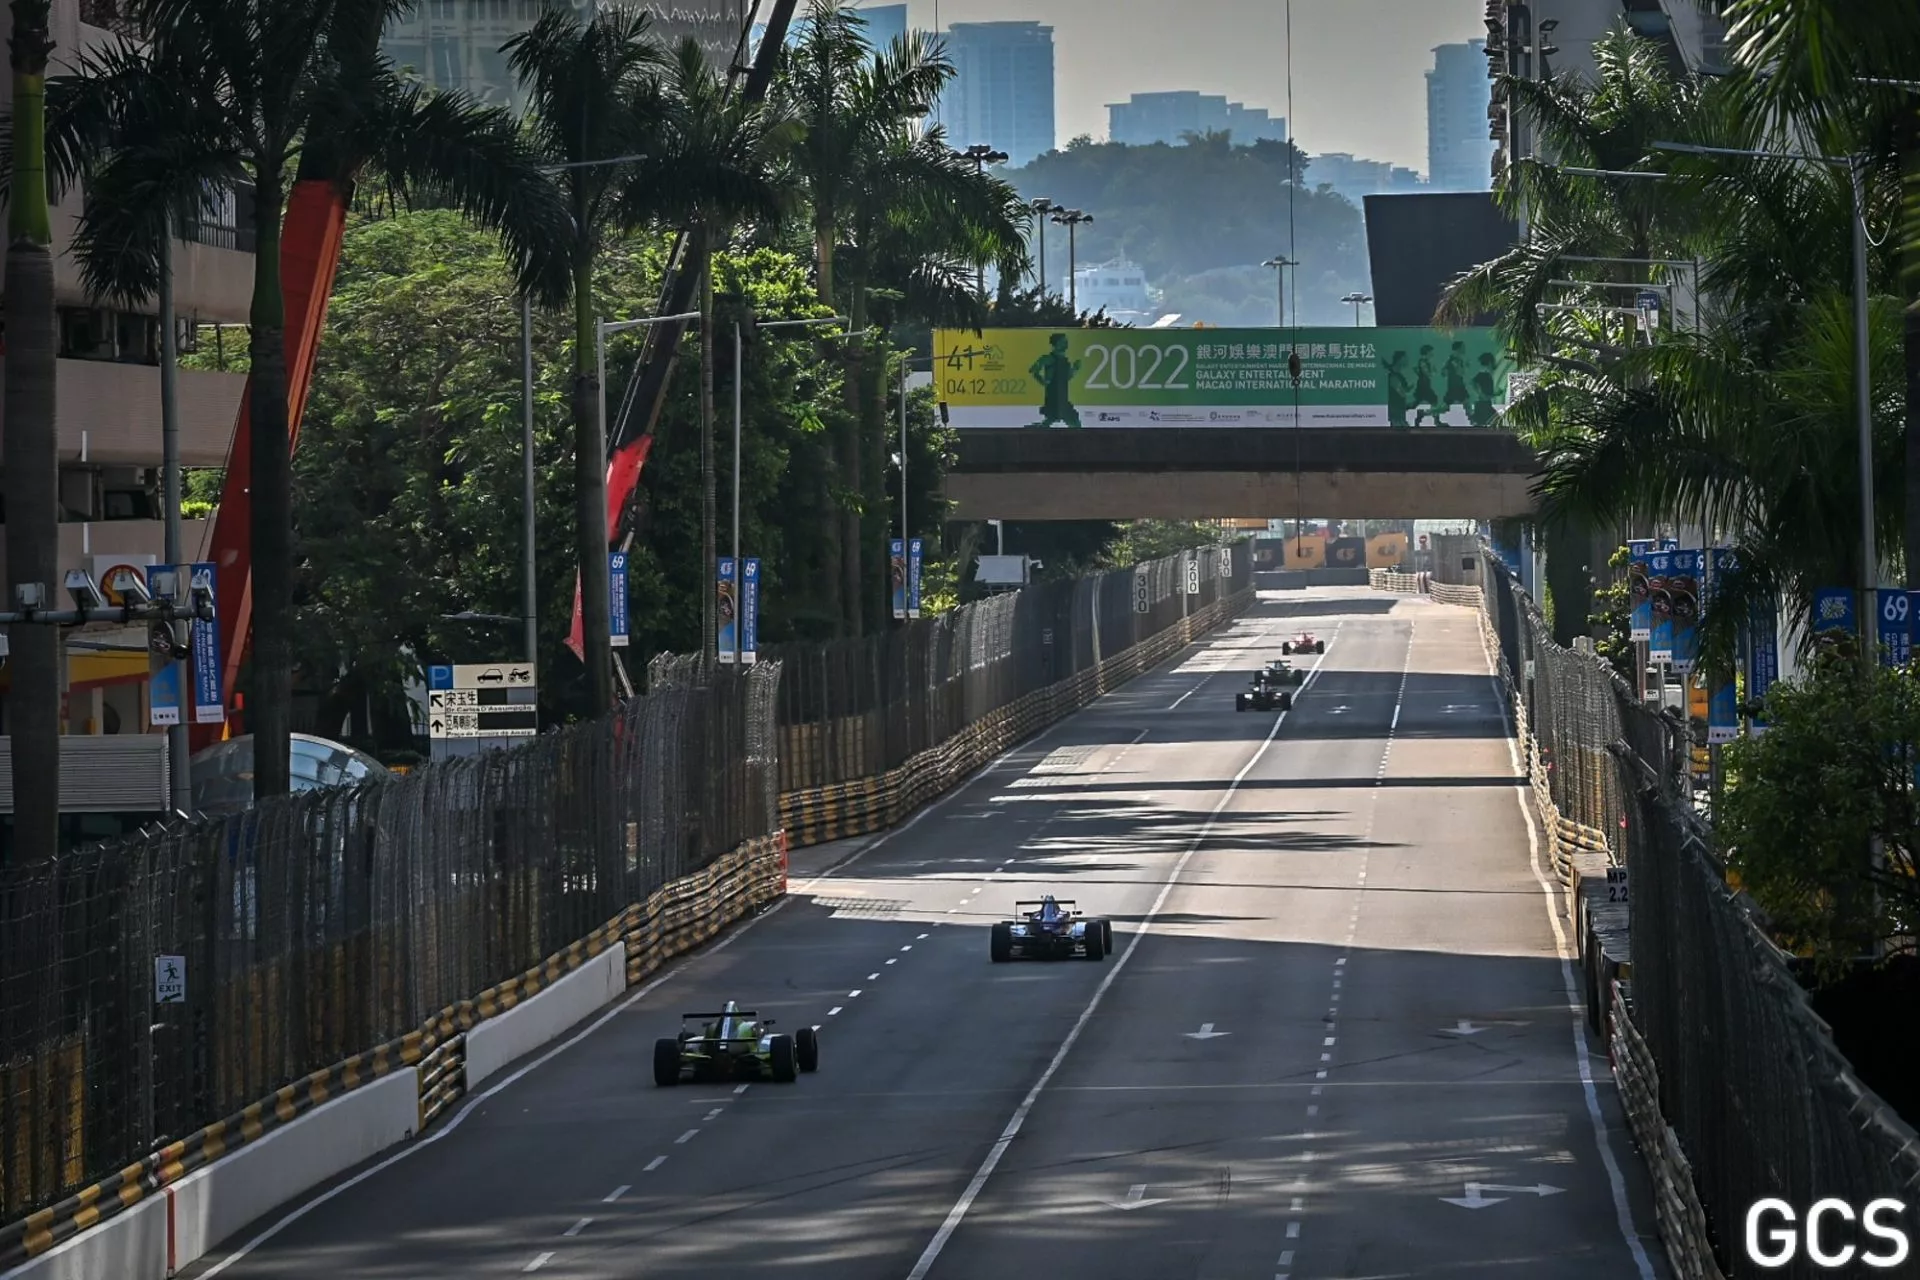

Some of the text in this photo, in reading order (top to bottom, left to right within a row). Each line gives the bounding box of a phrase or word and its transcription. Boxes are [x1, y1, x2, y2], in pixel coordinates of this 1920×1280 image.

[946, 345, 972, 370] 41
[1084, 344, 1189, 389] 2022
[1196, 370, 1236, 379] GALAXY
[1196, 380, 1232, 389] MACAO
[1319, 379, 1376, 388] MARATHON
[612, 555, 624, 569] 69
[745, 561, 756, 577] 69
[1189, 561, 1197, 592] 200
[1138, 575, 1147, 612] 300
[1884, 595, 1909, 621] 69
[432, 665, 449, 689] P
[446, 691, 477, 706] 宋玉生
[1608, 871, 1627, 883] MP
[1609, 887, 1628, 902] 2.2
[159, 984, 182, 992] EXIT
